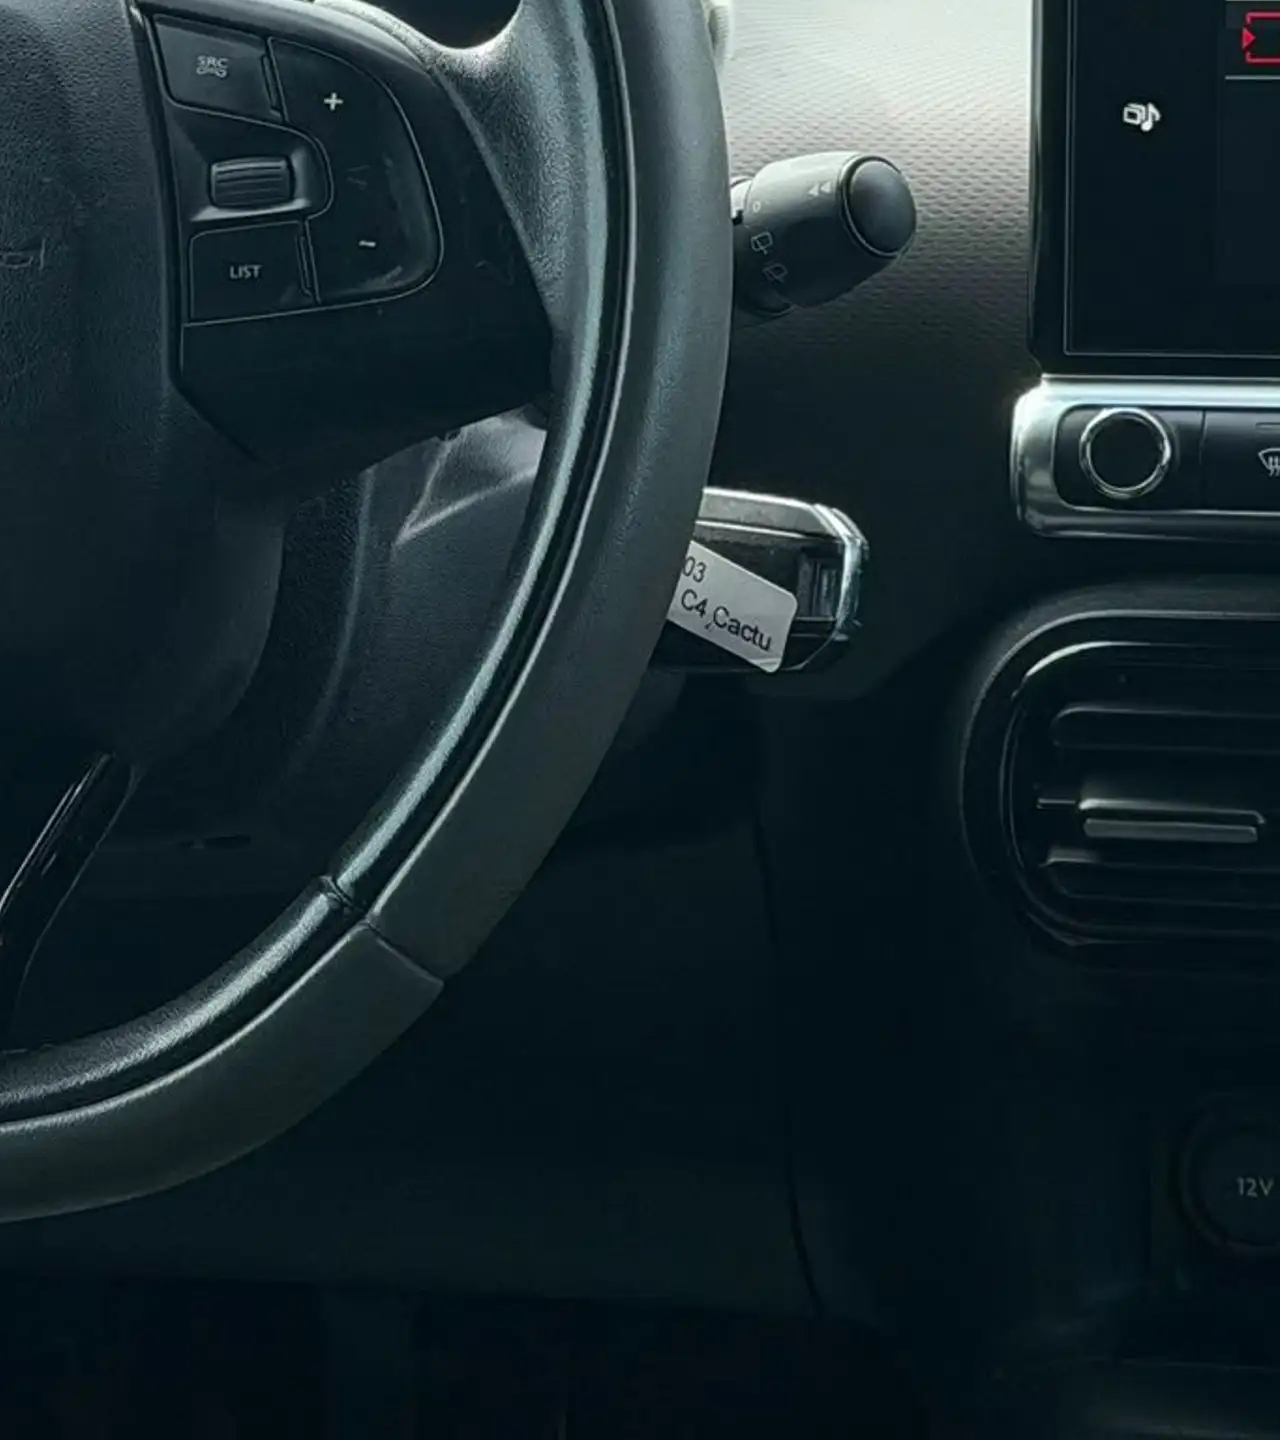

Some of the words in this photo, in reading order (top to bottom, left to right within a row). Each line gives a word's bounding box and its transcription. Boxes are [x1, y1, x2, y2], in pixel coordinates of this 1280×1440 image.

[229, 264, 262, 279] LIST
[681, 556, 707, 583] 03
[680, 588, 709, 618] C4
[712, 605, 773, 652] Cactu
[1235, 1175, 1275, 1198] 12V
